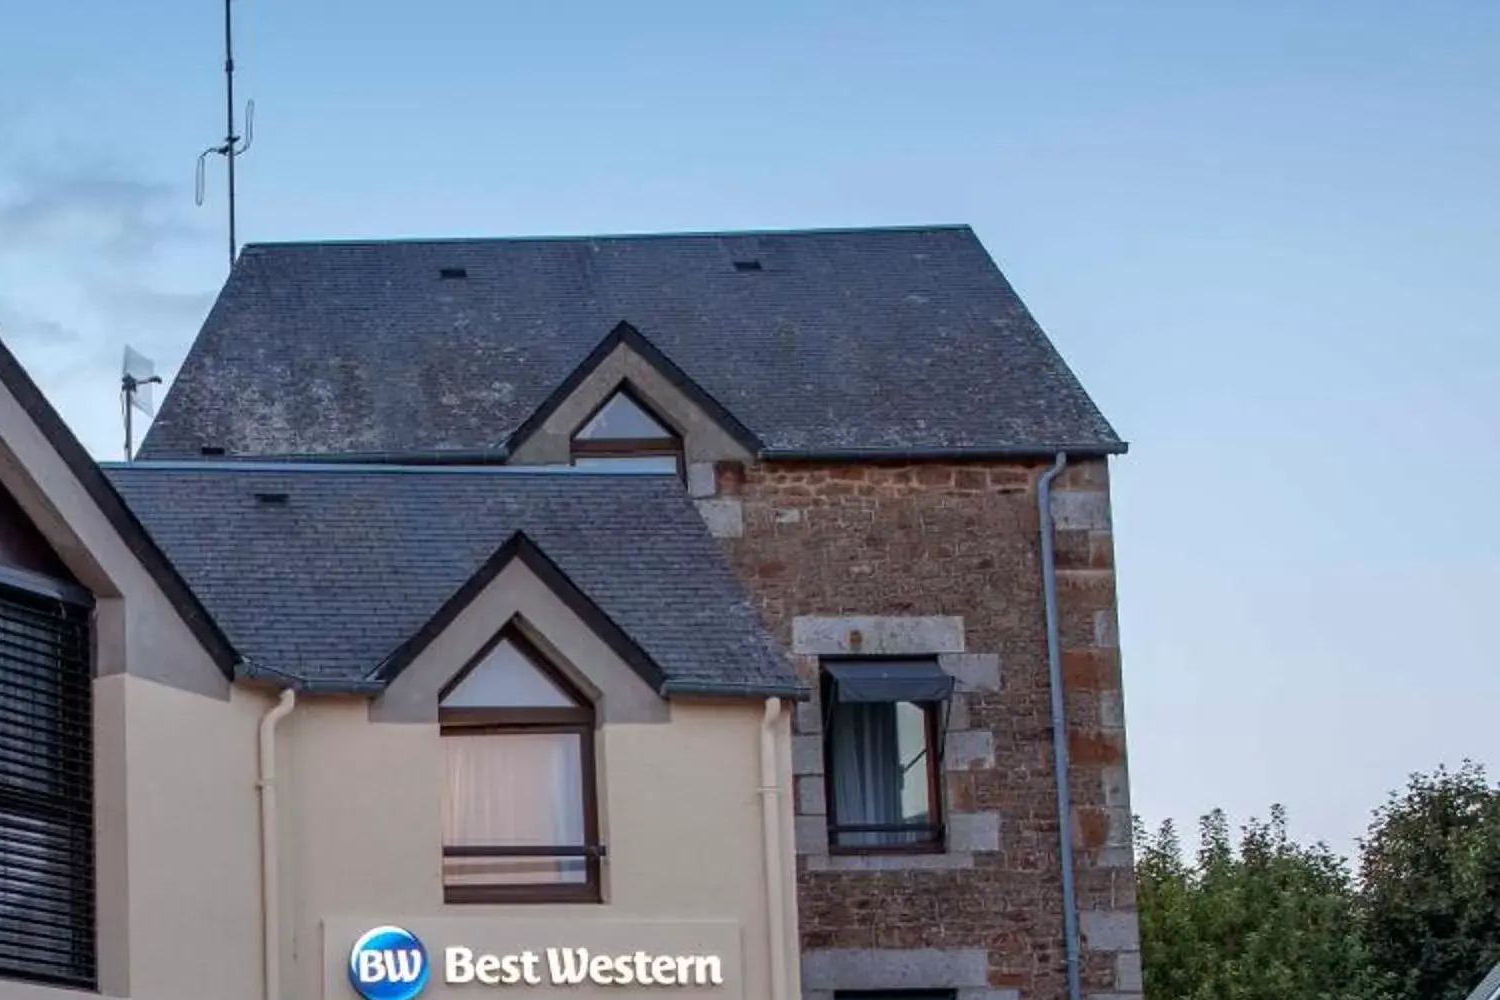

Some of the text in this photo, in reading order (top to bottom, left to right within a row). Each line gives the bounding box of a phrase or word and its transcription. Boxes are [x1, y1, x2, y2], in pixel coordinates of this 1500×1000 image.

[358, 948, 422, 983] BW
[444, 946, 723, 985] Best Western
